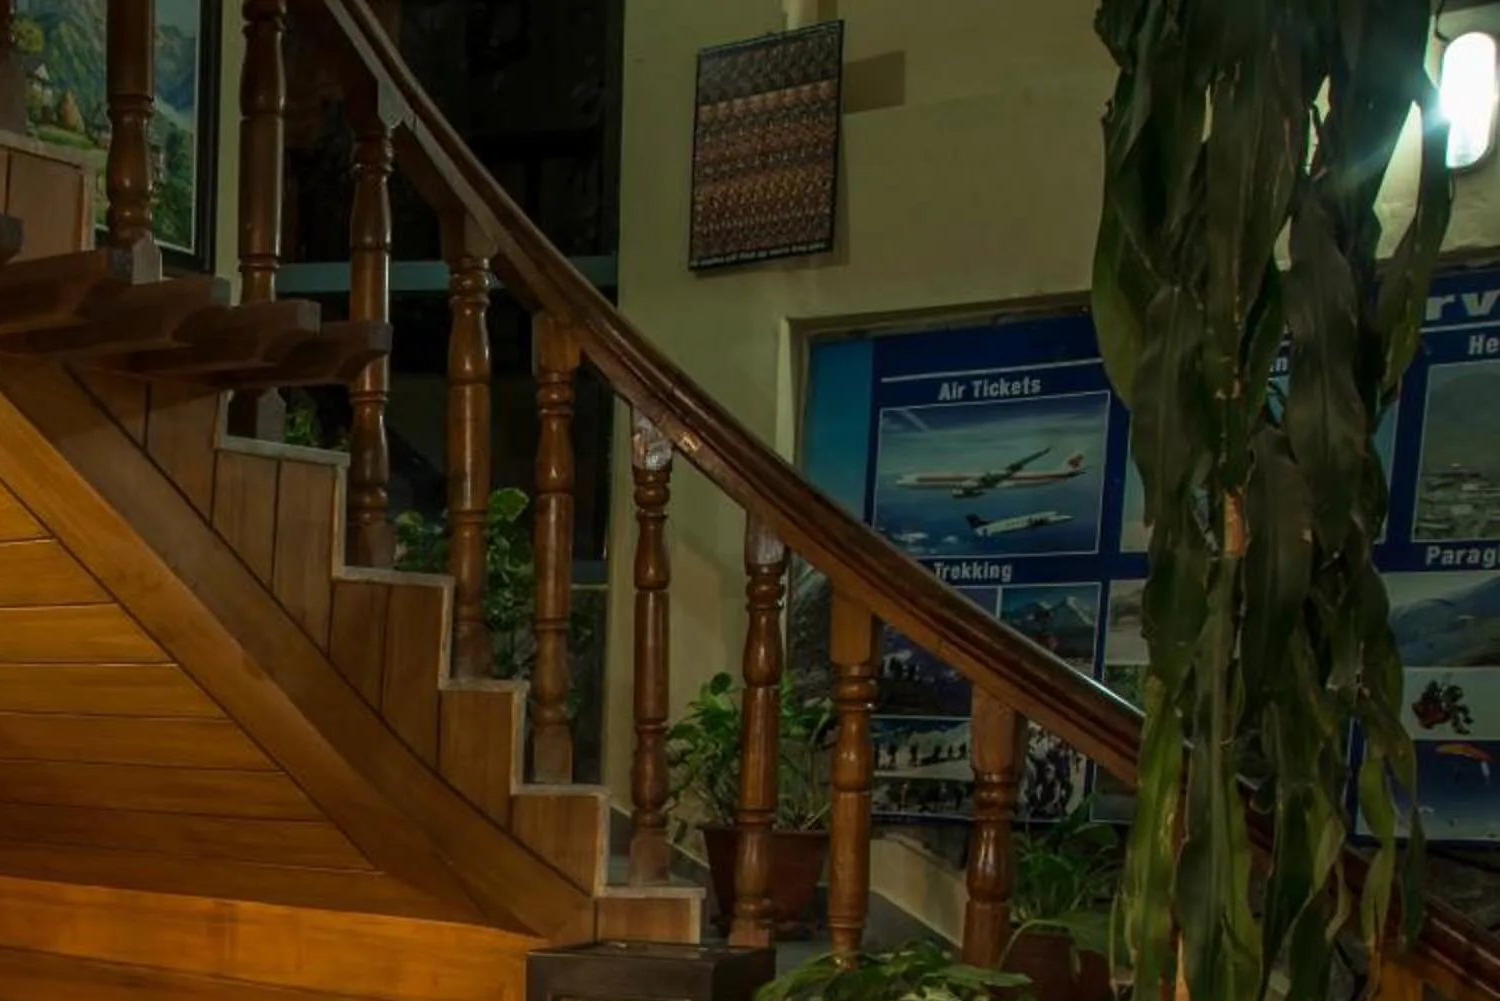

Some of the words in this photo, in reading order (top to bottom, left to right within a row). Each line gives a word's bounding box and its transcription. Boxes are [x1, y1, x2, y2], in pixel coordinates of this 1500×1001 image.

[937, 381, 966, 402] Air
[971, 376, 1042, 399] Tickets
[933, 561, 1013, 583] Trekking
